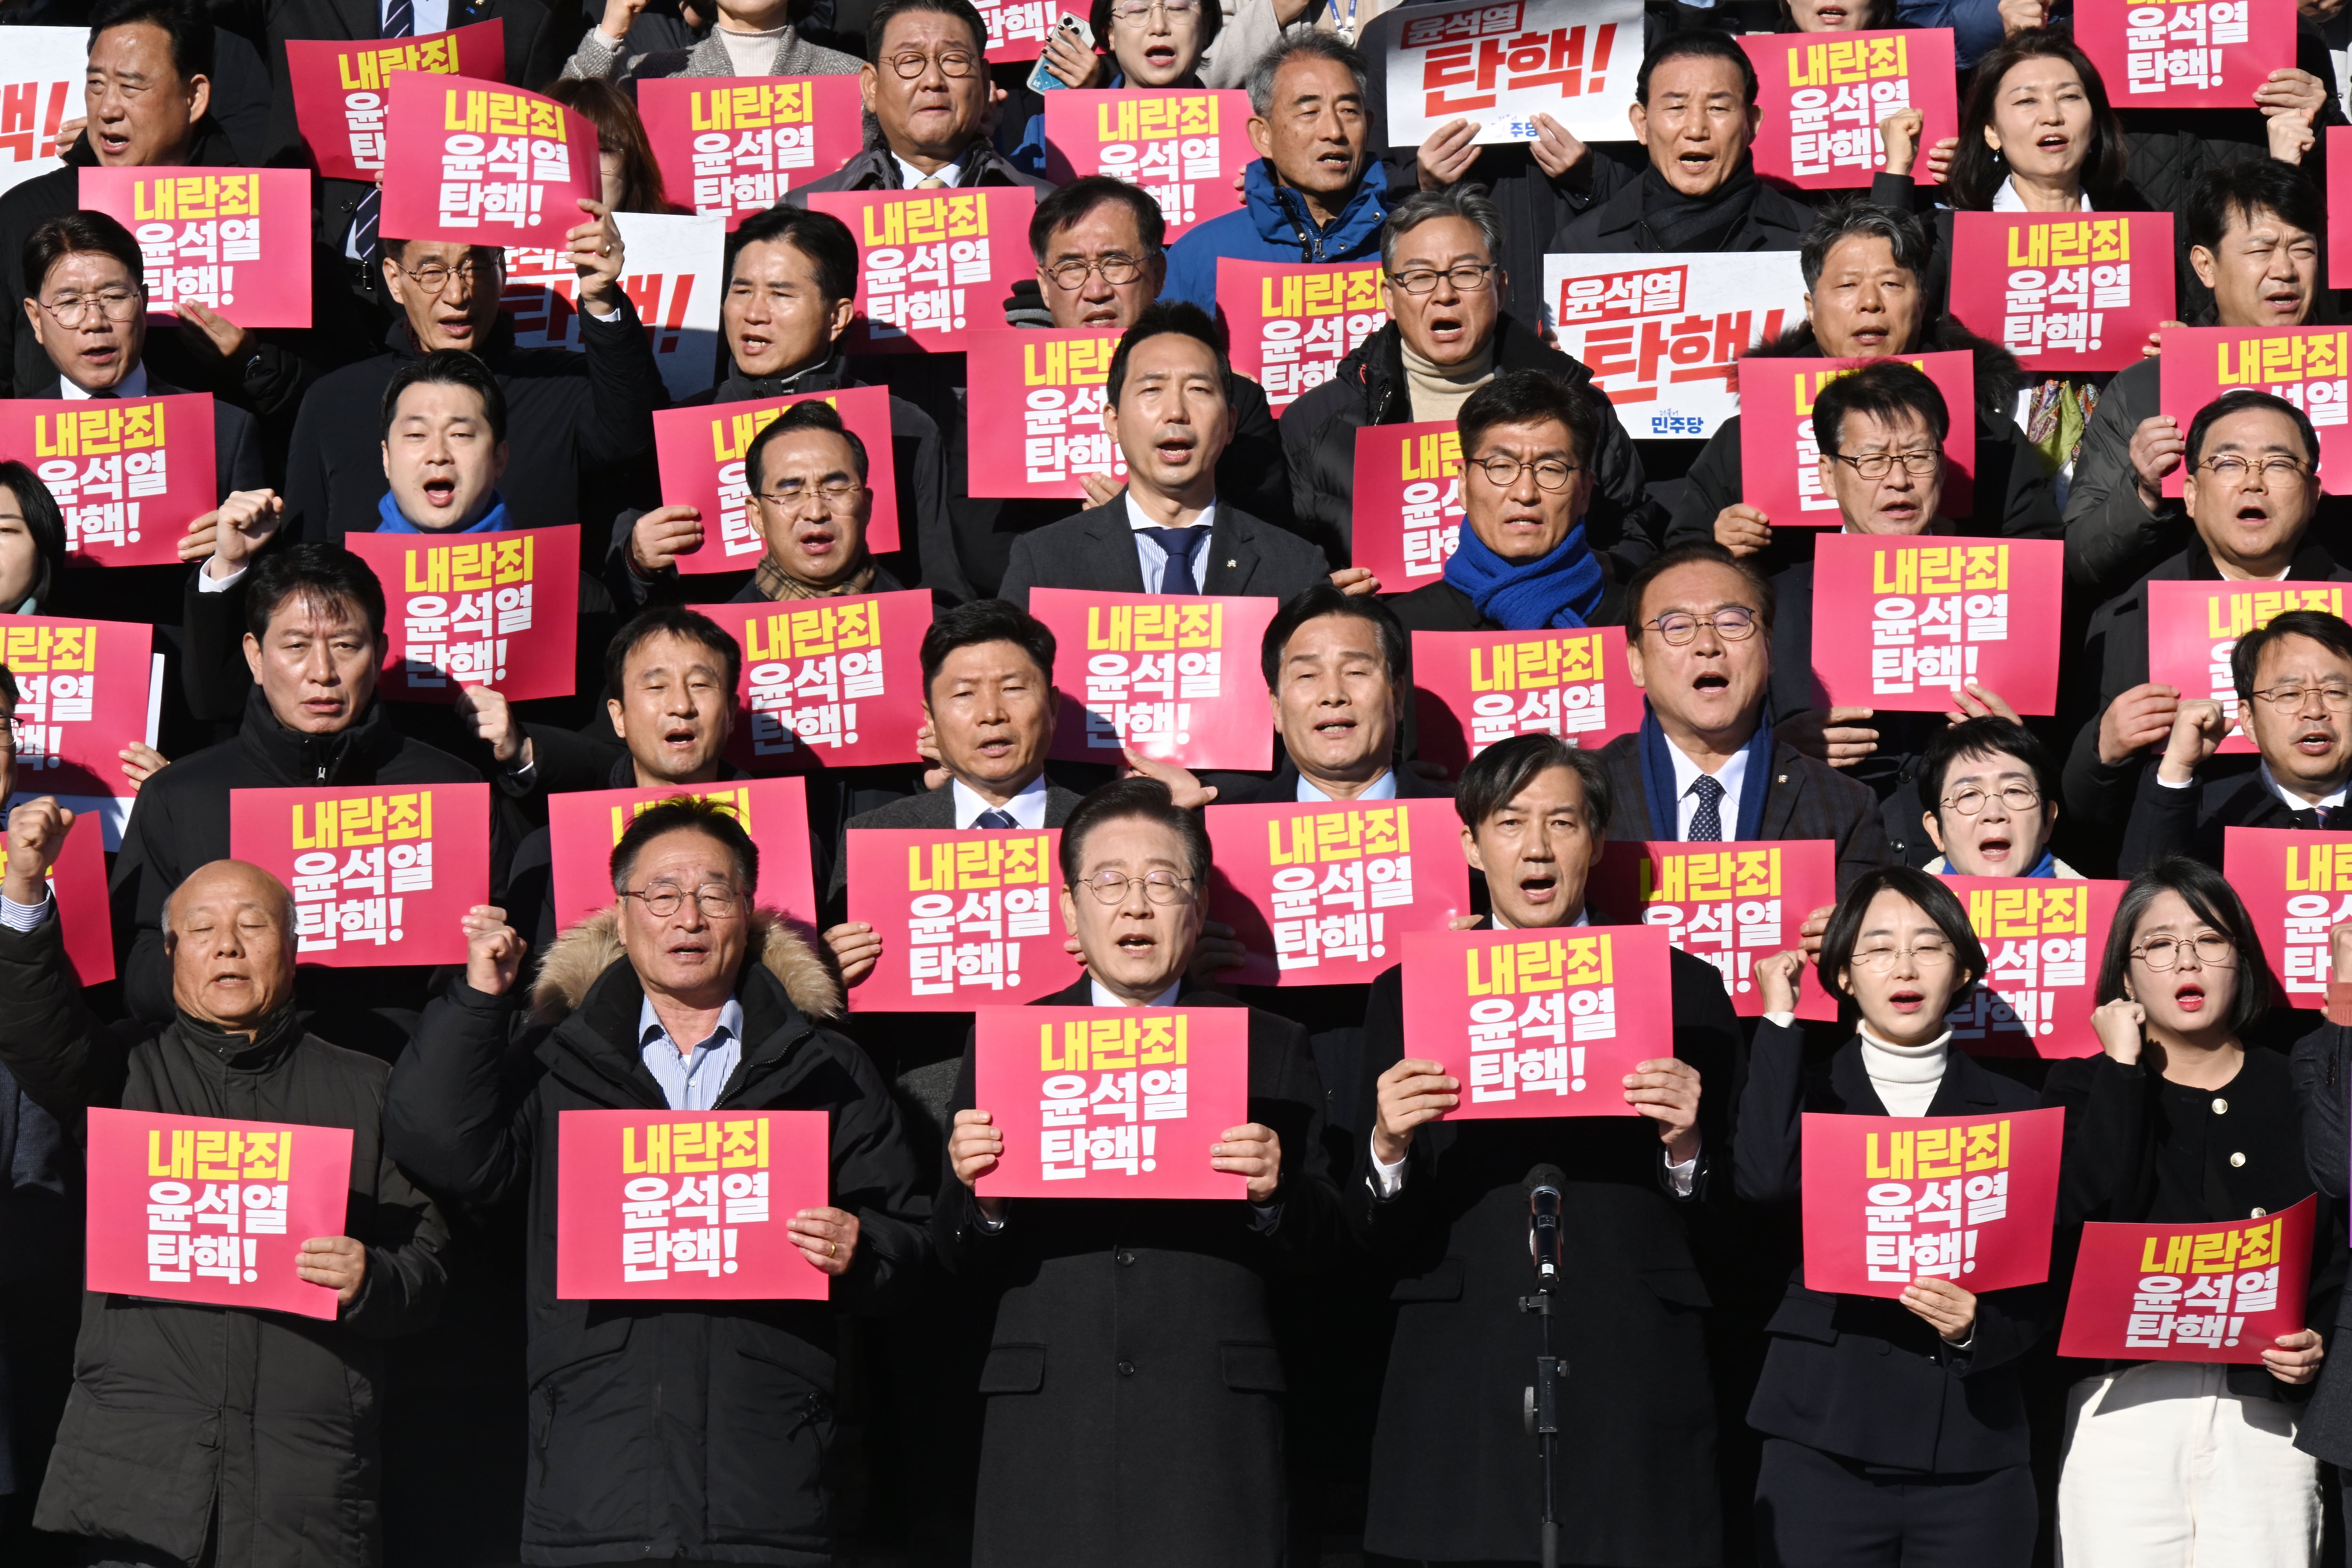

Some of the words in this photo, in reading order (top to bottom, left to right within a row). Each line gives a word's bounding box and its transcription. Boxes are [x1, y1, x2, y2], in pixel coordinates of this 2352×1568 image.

[1408, 3, 1518, 41] 윤석열
[2126, 0, 2249, 50] 윤석열
[1422, 23, 1617, 118] 탄핵!
[1788, 35, 1907, 87] 내란죄
[2128, 48, 2223, 94] 탄핵!
[445, 89, 567, 143] 내란죄
[691, 81, 813, 131] 내란죄
[1098, 95, 1219, 142] 내란죄
[1790, 79, 1909, 133] 윤석열
[442, 135, 570, 183] 윤석열
[692, 126, 815, 176] 윤석열
[134, 174, 260, 221] 내란죄
[439, 182, 543, 228] 탄핵!
[863, 193, 988, 247] 내란죄
[1143, 183, 1196, 226] 핵!
[135, 218, 260, 262] 윤석열
[865, 238, 991, 288] 윤석열
[2008, 218, 2130, 267] 내란죄
[867, 289, 966, 340] 탄핵!
[1565, 271, 1679, 320] 윤석열
[2006, 264, 2130, 313] 윤석열
[2004, 312, 2103, 356] 탄핵!
[2218, 332, 2348, 385] 내란죄
[1025, 338, 1122, 386] 내란
[35, 402, 165, 457] 내란죄
[1025, 386, 1109, 435] 윤석
[1652, 417, 1704, 434] 민주당
[1659, 408, 1678, 417] 더불어
[37, 449, 167, 506] 윤석열
[405, 535, 533, 593] 내란죄
[1873, 545, 2009, 595] 내란죄
[404, 584, 532, 643] 윤석열
[746, 600, 881, 661] 내란죄
[1088, 603, 1223, 652] 내란죄
[1871, 594, 2007, 646] 윤석열
[0, 626, 96, 672] 란죄
[405, 638, 507, 688] 탄핵!
[1470, 634, 1604, 692] 내란죄
[1872, 645, 1979, 695] 탄핵!
[14, 675, 94, 722] 석열
[749, 649, 884, 711] 윤석열
[1086, 652, 1221, 701] 윤석열
[751, 703, 859, 756] 탄핵!
[1086, 701, 1191, 748] 탄핵!
[1471, 683, 1605, 742] 윤석열
[292, 791, 432, 850] 내란죄
[1269, 805, 1410, 866] 내란죄
[293, 842, 433, 901] 윤석열
[909, 835, 1049, 892] 내란죄
[1271, 855, 1413, 920] 윤석열
[1640, 848, 1781, 902] 내란죄
[296, 897, 404, 954] 탄핵!
[908, 888, 1050, 945] 윤석열
[1274, 913, 1386, 971] 탄핵!
[909, 942, 1020, 996] 탄핵!
[1466, 933, 1613, 997] 내란죄
[1979, 938, 2086, 988] 석열
[1040, 1014, 1188, 1071] 내란죄
[1468, 987, 1616, 1051] 윤석열
[1040, 1068, 1188, 1127] 윤석열
[1470, 1046, 1586, 1104] 탄핵!
[148, 1130, 292, 1181] 내란죄
[623, 1118, 769, 1174] 내란죄
[1041, 1126, 1156, 1181] 탄핵!
[1866, 1120, 2010, 1180] 내란죄
[146, 1181, 288, 1234] 윤석열
[622, 1171, 769, 1229] 윤석열
[1865, 1170, 2008, 1232] 윤석열
[147, 1234, 257, 1285] 탄핵!
[622, 1227, 738, 1283] 탄핵!
[1866, 1229, 1978, 1282] 탄핵!
[2140, 1218, 2282, 1274] 내란죄
[2133, 1266, 2279, 1313] 윤석열
[2125, 1313, 2243, 1349] 탄핵!
